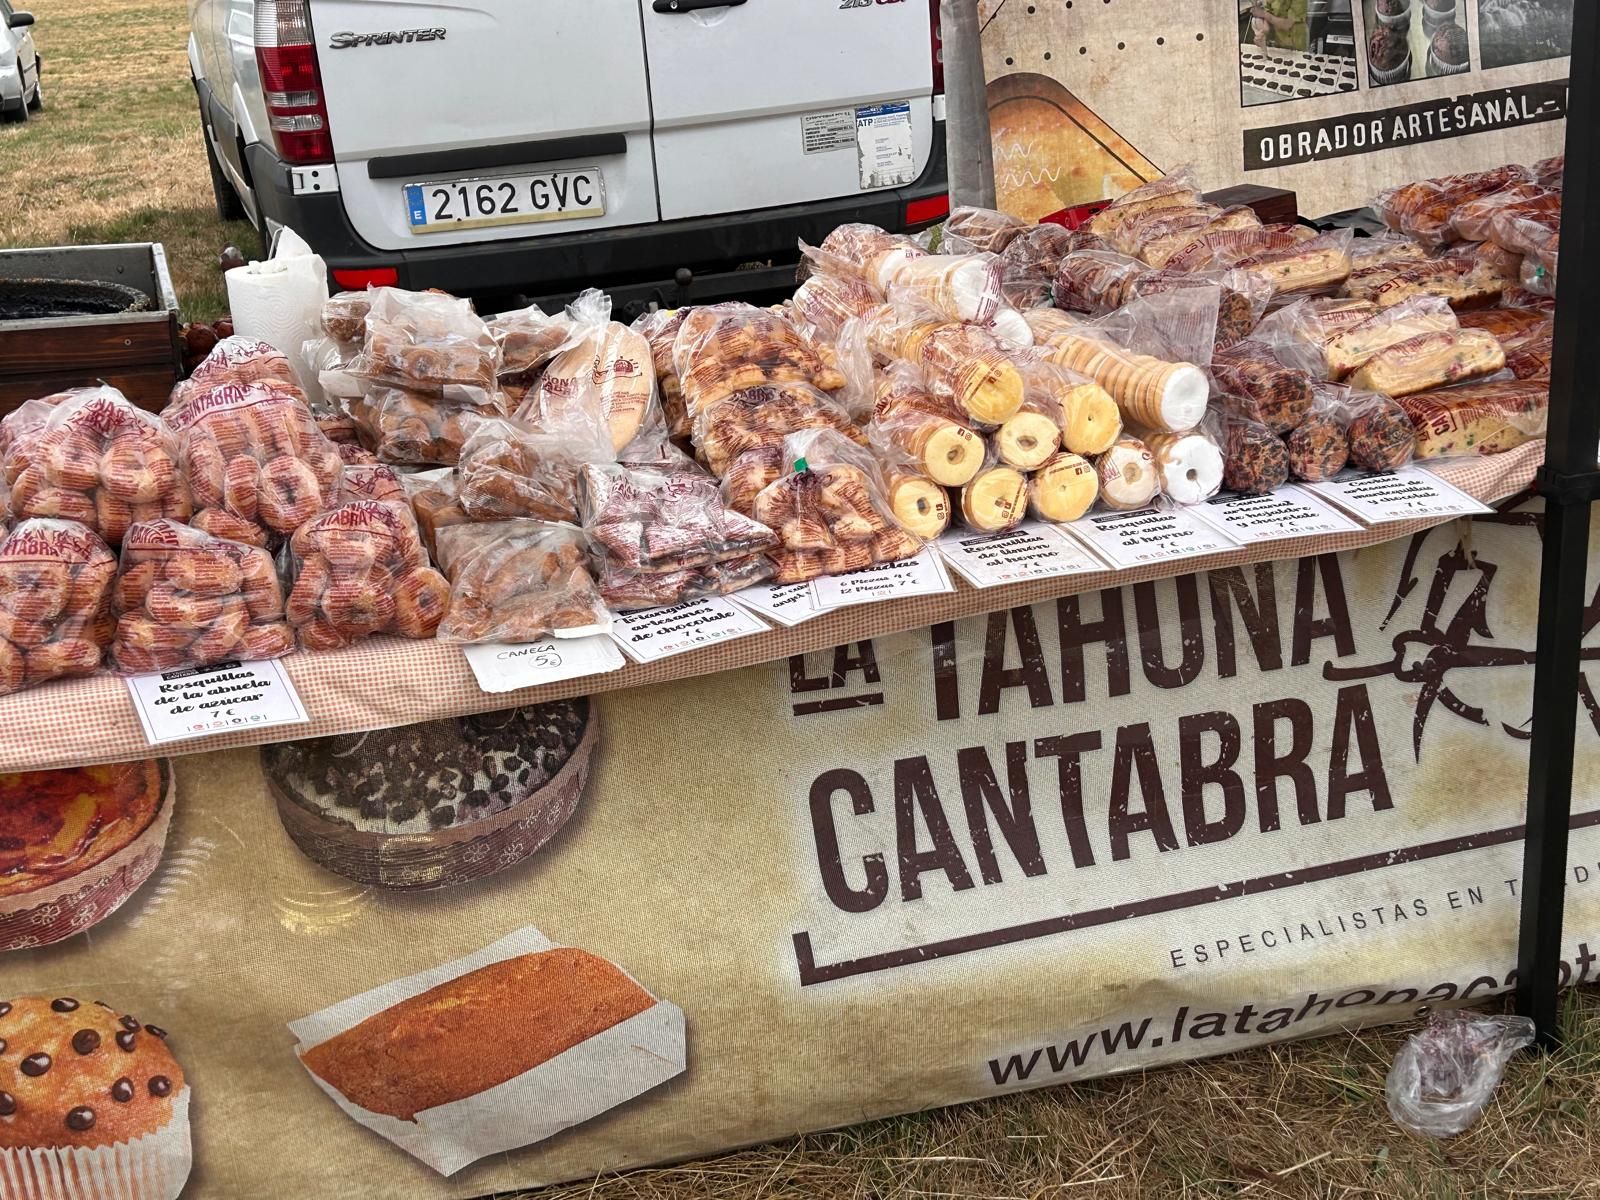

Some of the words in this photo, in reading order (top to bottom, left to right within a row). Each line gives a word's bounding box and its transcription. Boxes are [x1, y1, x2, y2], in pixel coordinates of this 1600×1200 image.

[857, 118, 874, 128] ATP
[1259, 118, 1385, 162] OBRADOR
[432, 182, 519, 220] 2162
[530, 174, 593, 210] GVC
[414, 210, 423, 220] E
[1380, 491, 1440, 503] chocolate
[1095, 513, 1177, 532] Rosquillas
[1225, 514, 1245, 522] de
[1251, 512, 1320, 525] chocolate
[1119, 529, 1140, 537] de
[1122, 538, 1140, 546] al
[1140, 530, 1196, 543] horno
[962, 536, 1045, 554] Rosquillas
[977, 551, 999, 560] de
[986, 558, 1004, 567] al
[1006, 550, 1060, 563] horno
[851, 576, 890, 586] Piezas
[856, 582, 895, 593] Piezas
[631, 606, 715, 632] artesanos
[631, 632, 654, 643] de
[656, 610, 736, 636] chocolate
[788, 636, 882, 694] LA
[158, 671, 255, 693] Rosquillas
[154, 696, 180, 706] de
[183, 690, 204, 700] la
[207, 679, 272, 696] abuela
[170, 703, 195, 715] de
[198, 692, 264, 709] azúcar
[210, 710, 219, 719] 7
[225, 708, 236, 716] €
[808, 683, 1395, 914] CANTABRA
[1170, 898, 1430, 968] ESPECIALISTAS
[1447, 885, 1484, 910] EN
